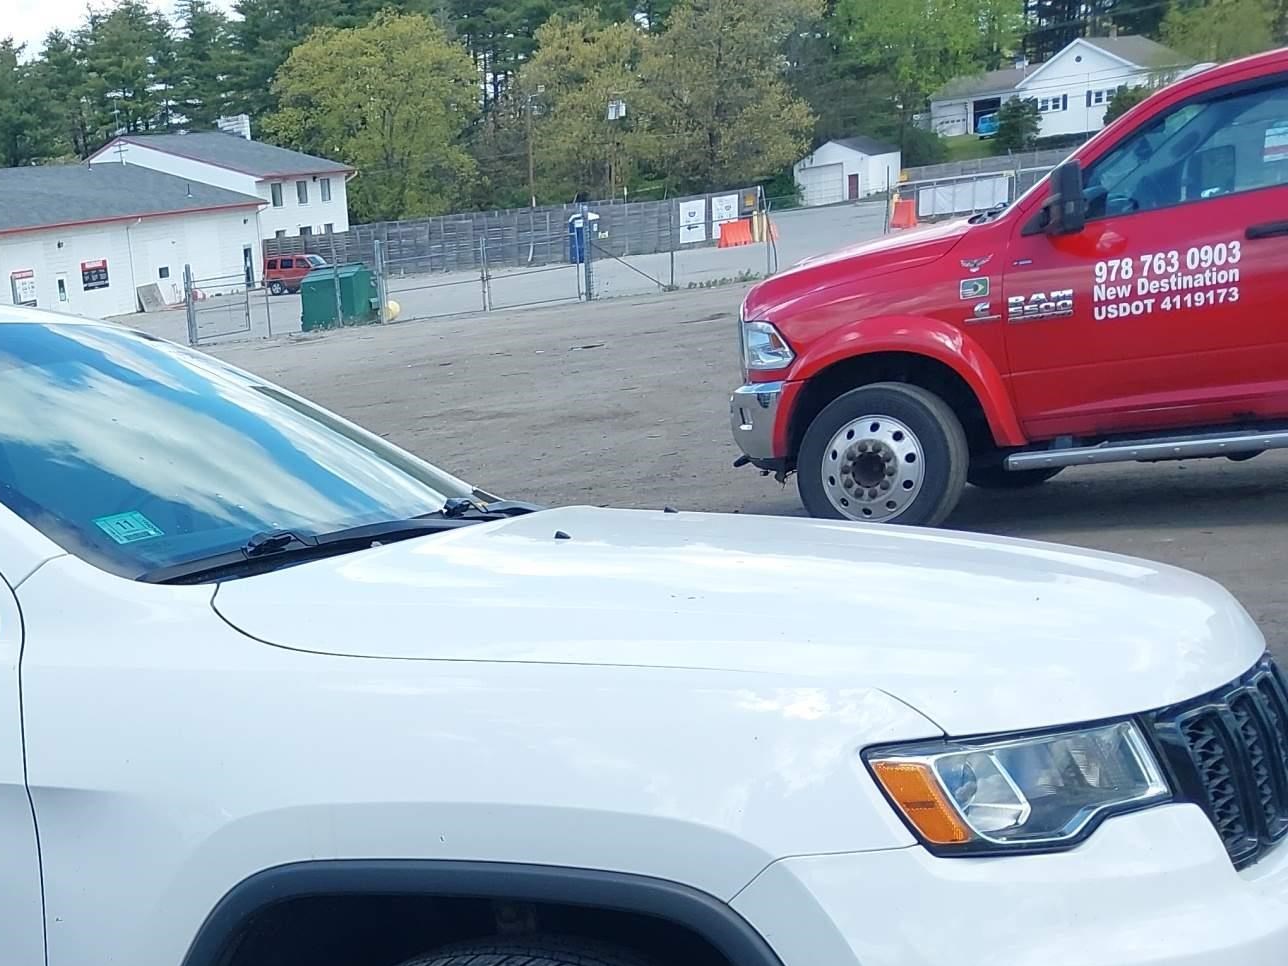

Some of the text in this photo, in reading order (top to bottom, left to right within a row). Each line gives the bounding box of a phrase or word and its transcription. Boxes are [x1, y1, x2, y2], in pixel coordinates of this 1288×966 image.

[1094, 240, 1241, 284] 978 763 0903
[1008, 289, 1073, 306] RAM
[1093, 267, 1240, 302] New Destination
[1008, 299, 1073, 318] 5500
[1093, 298, 1155, 321] USDOT
[1160, 287, 1240, 311] 4119173
